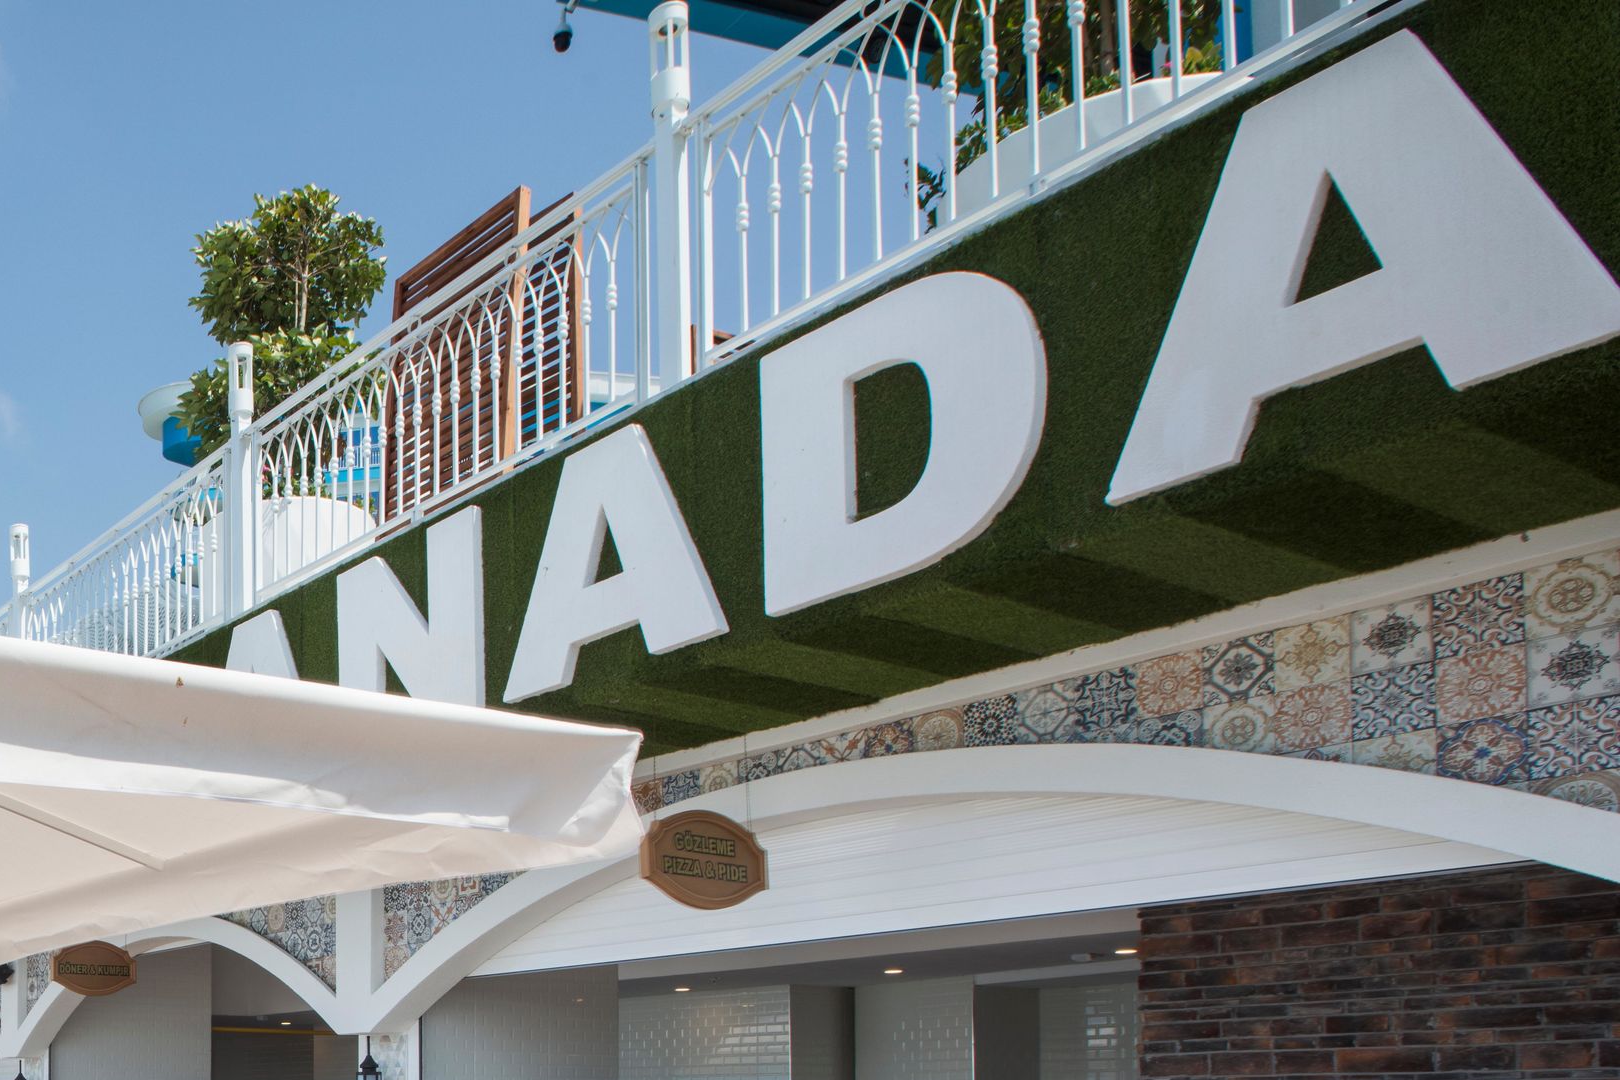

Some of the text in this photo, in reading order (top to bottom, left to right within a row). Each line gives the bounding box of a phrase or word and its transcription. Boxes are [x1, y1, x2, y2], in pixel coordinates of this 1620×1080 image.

[674, 831, 735, 857] GÖZLEME
[663, 855, 748, 883] PIZZA & PIDE
[59, 961, 87, 974] DÖNER
[88, 964, 96, 975] &
